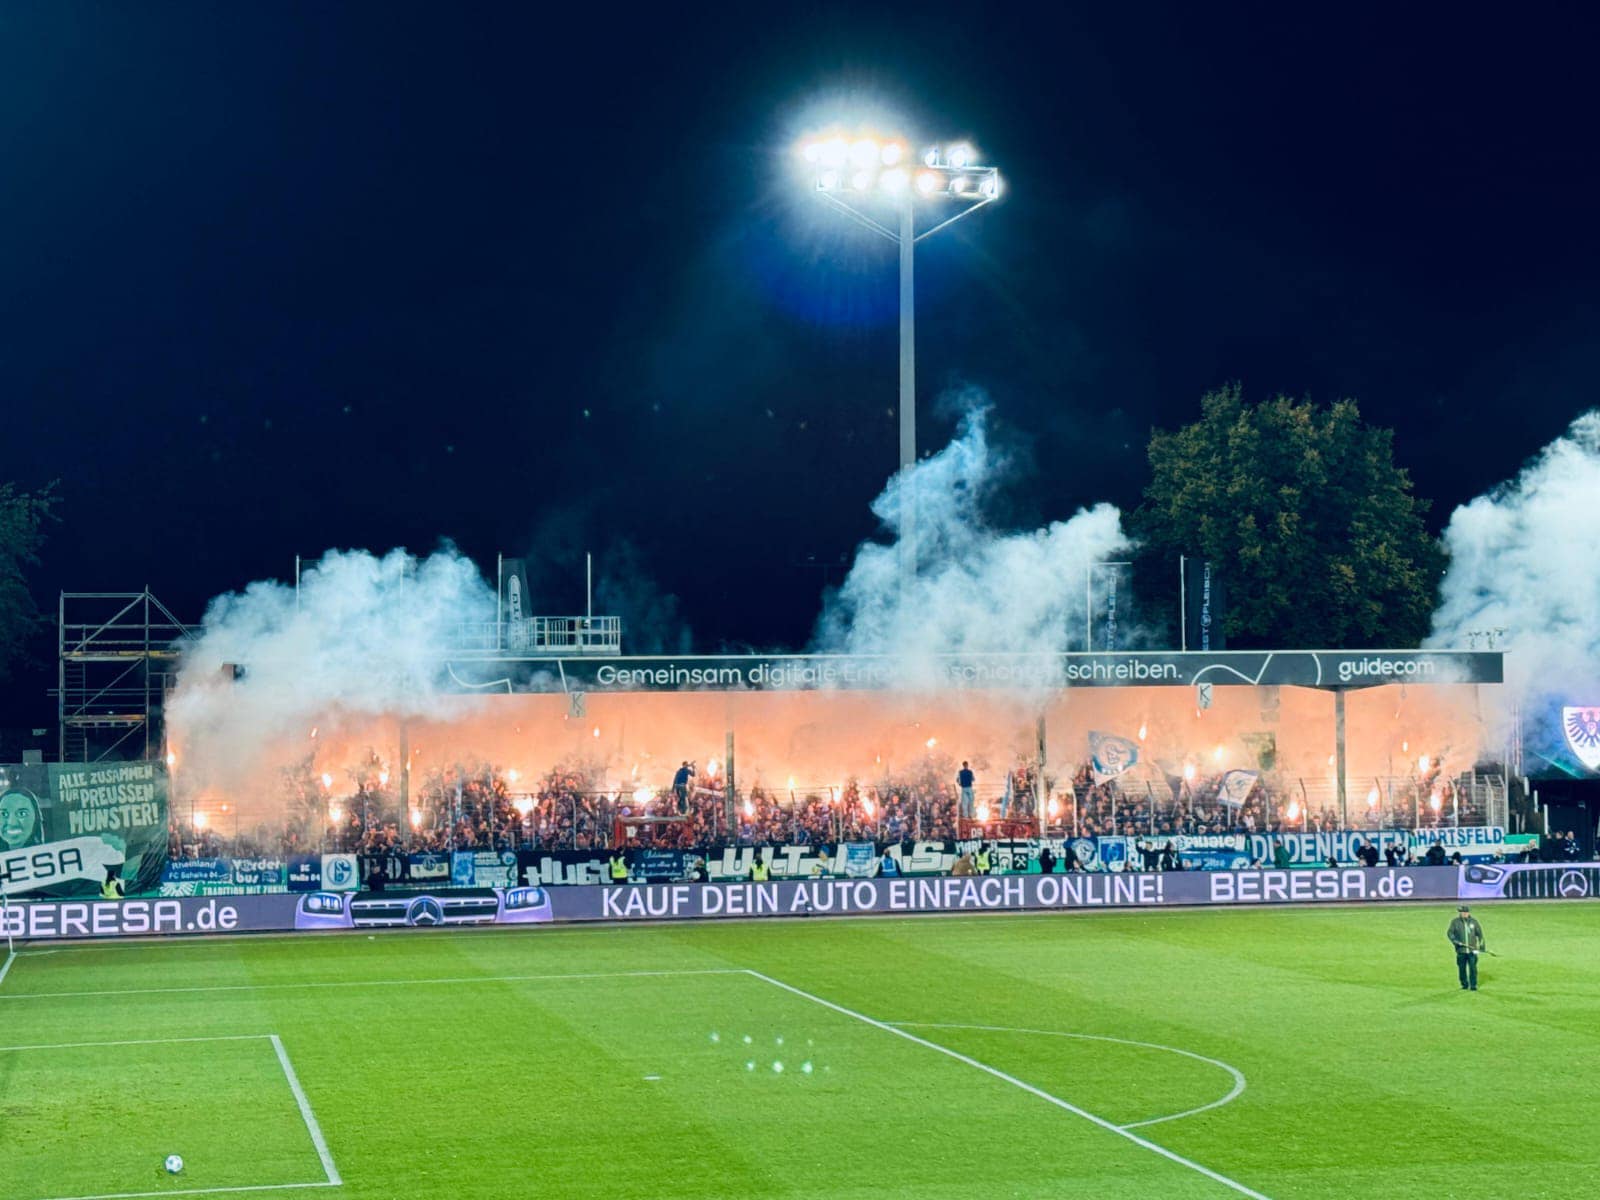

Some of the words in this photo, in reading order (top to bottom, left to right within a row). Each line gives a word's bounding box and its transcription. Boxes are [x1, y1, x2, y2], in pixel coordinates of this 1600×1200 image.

[597, 664, 741, 685] Gemeinsam
[748, 662, 836, 688] digitale
[1067, 659, 1182, 680] schreiben.
[1338, 657, 1435, 682] guidecom
[59, 772, 87, 789] ALLE
[90, 765, 153, 784] ZUSAMMEN
[80, 783, 154, 808] PREUSSEN
[69, 802, 159, 834] MÜNSTER!
[1416, 828, 1502, 846] HARTSFELD
[0, 848, 83, 883] ESA
[603, 886, 689, 917] KAUF
[702, 884, 779, 914] DEIN
[790, 881, 877, 912] AUTO
[890, 878, 1024, 909] EINFACH
[1037, 874, 1163, 905] ONLINE!
[1210, 869, 1414, 901] BERESA.de
[0, 900, 238, 936] BERESA.de
